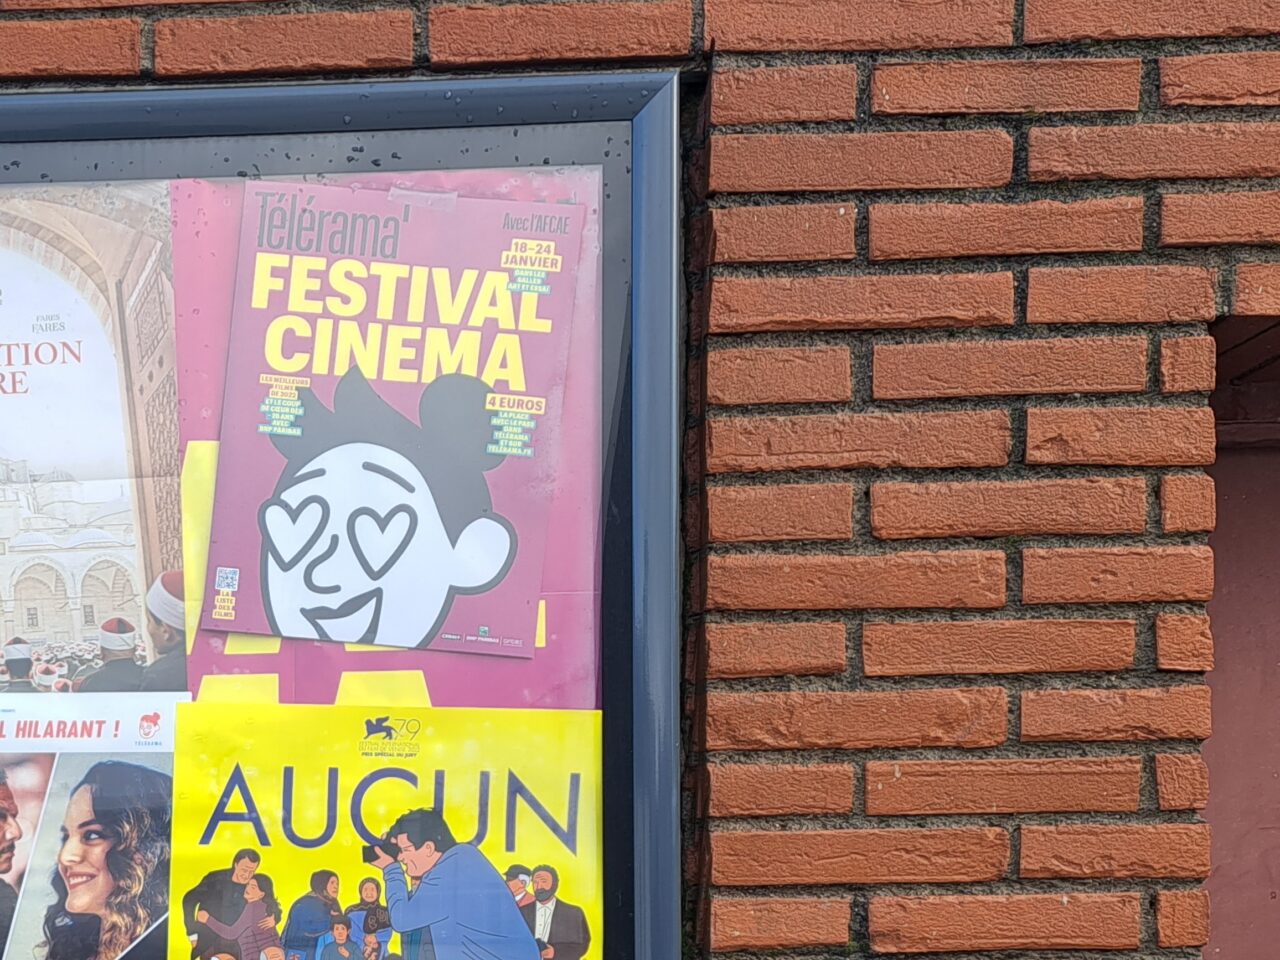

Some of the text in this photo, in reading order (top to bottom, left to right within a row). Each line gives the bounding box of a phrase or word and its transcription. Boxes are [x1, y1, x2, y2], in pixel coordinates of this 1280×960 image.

[503, 212, 529, 232] Avec
[503, 254, 559, 269] JANVIER
[251, 252, 552, 333] FESTIVAL
[264, 315, 527, 391] CINEMA
[488, 396, 543, 411] 4 EUROS
[15, 719, 106, 739] HILARANT
[198, 762, 582, 857] AUCUN
